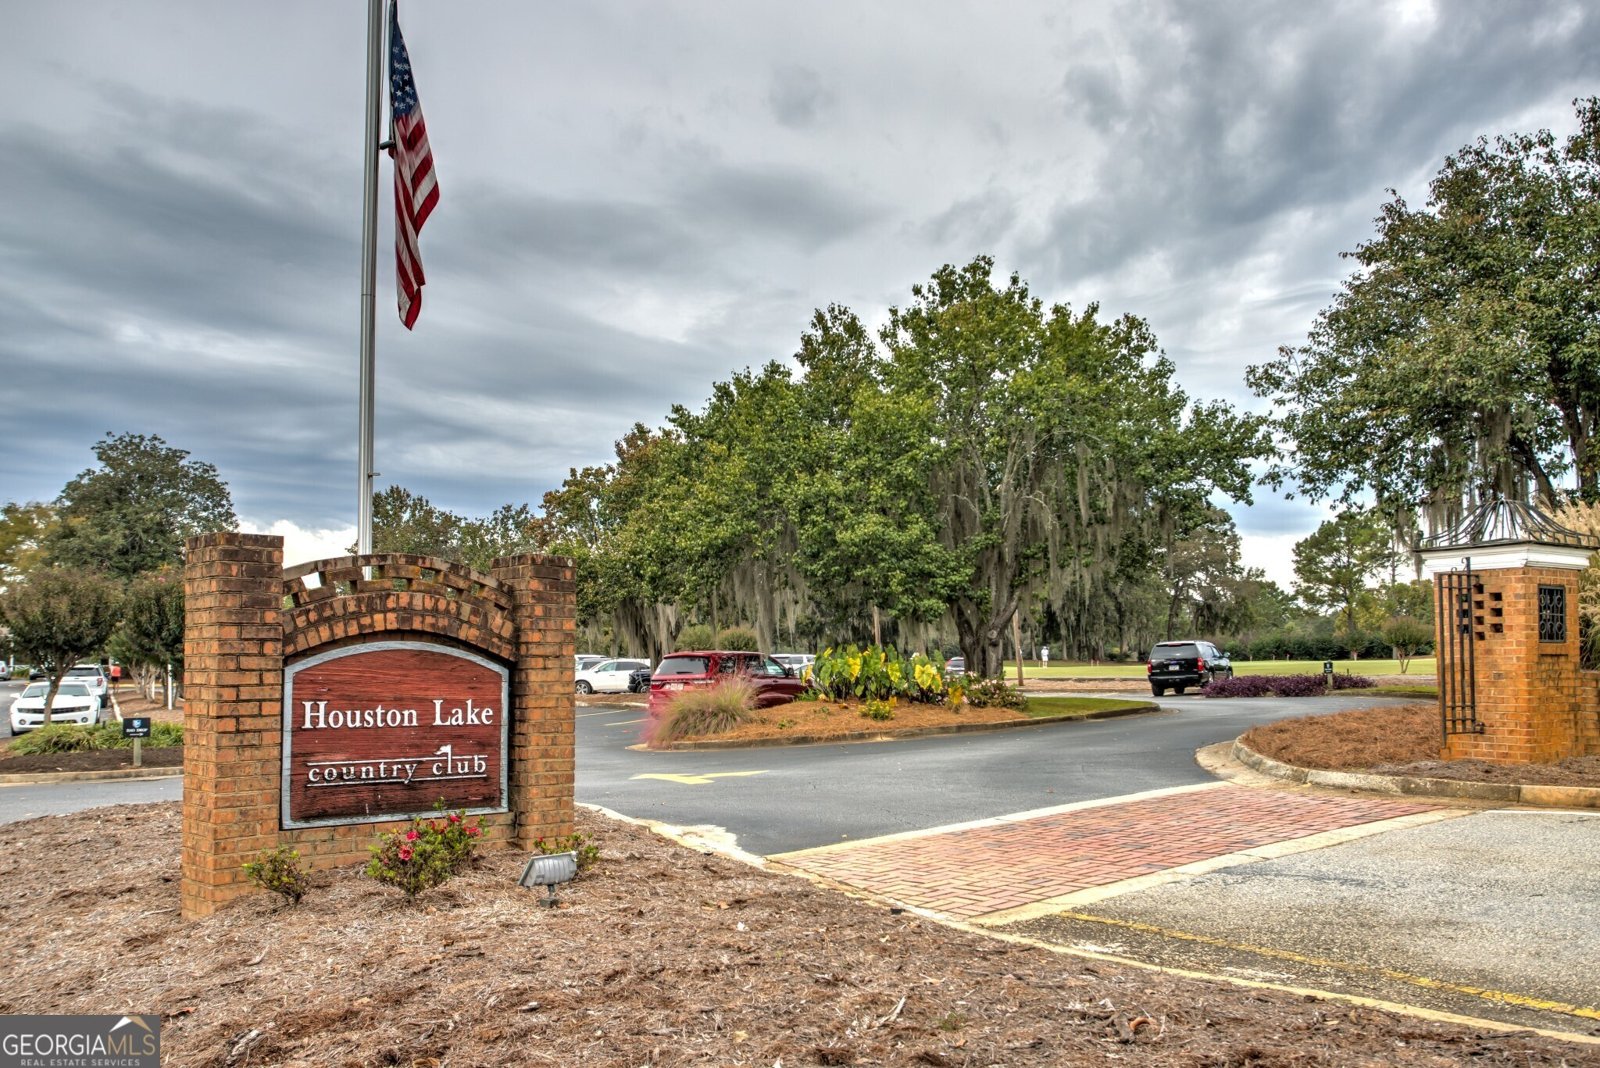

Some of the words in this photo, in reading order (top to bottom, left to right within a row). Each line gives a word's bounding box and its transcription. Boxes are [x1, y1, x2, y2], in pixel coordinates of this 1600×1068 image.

[301, 700, 418, 729] Houston
[432, 699, 494, 726] Lake
[308, 761, 417, 784] country
[432, 744, 487, 775] club
